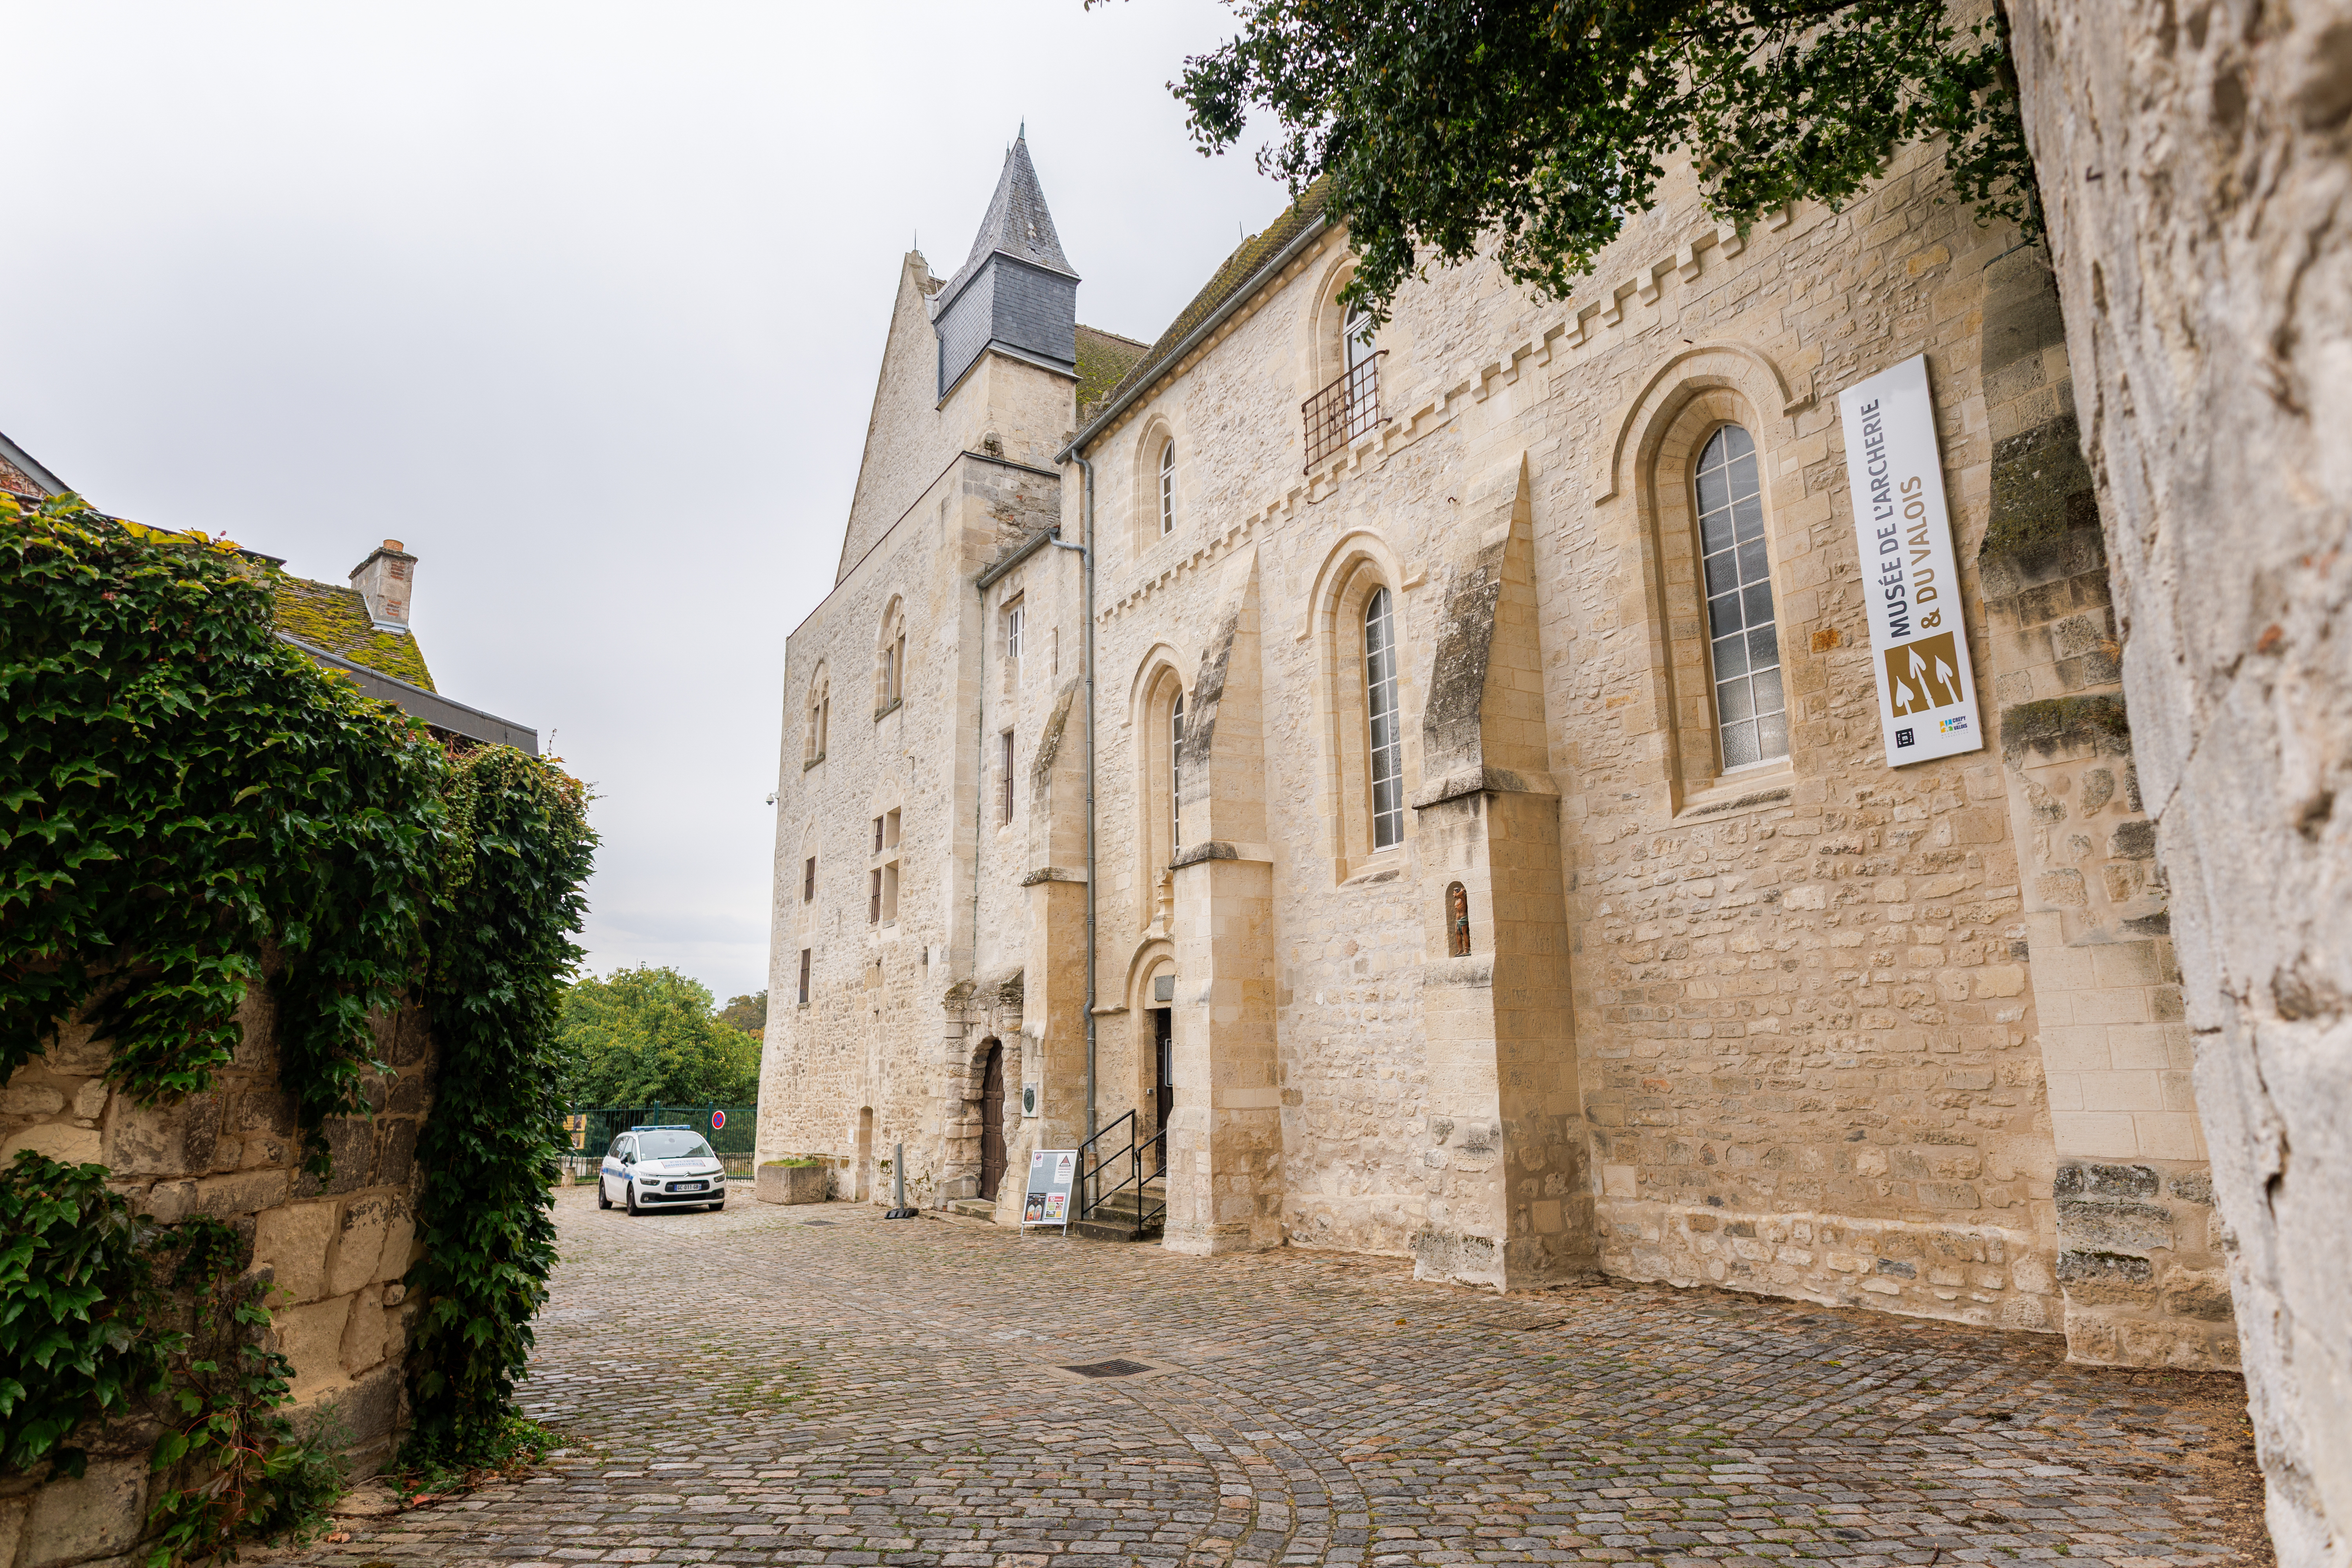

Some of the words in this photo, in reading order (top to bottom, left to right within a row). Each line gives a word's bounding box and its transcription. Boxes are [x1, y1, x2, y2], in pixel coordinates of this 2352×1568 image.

[1861, 399, 1893, 521] L'ARCHERIE
[1877, 523, 1899, 555] DE
[1900, 476, 1931, 566] VALOIS
[1878, 557, 1911, 638] MUSÉE
[1913, 568, 1938, 604] DU
[1921, 607, 1941, 629] &
